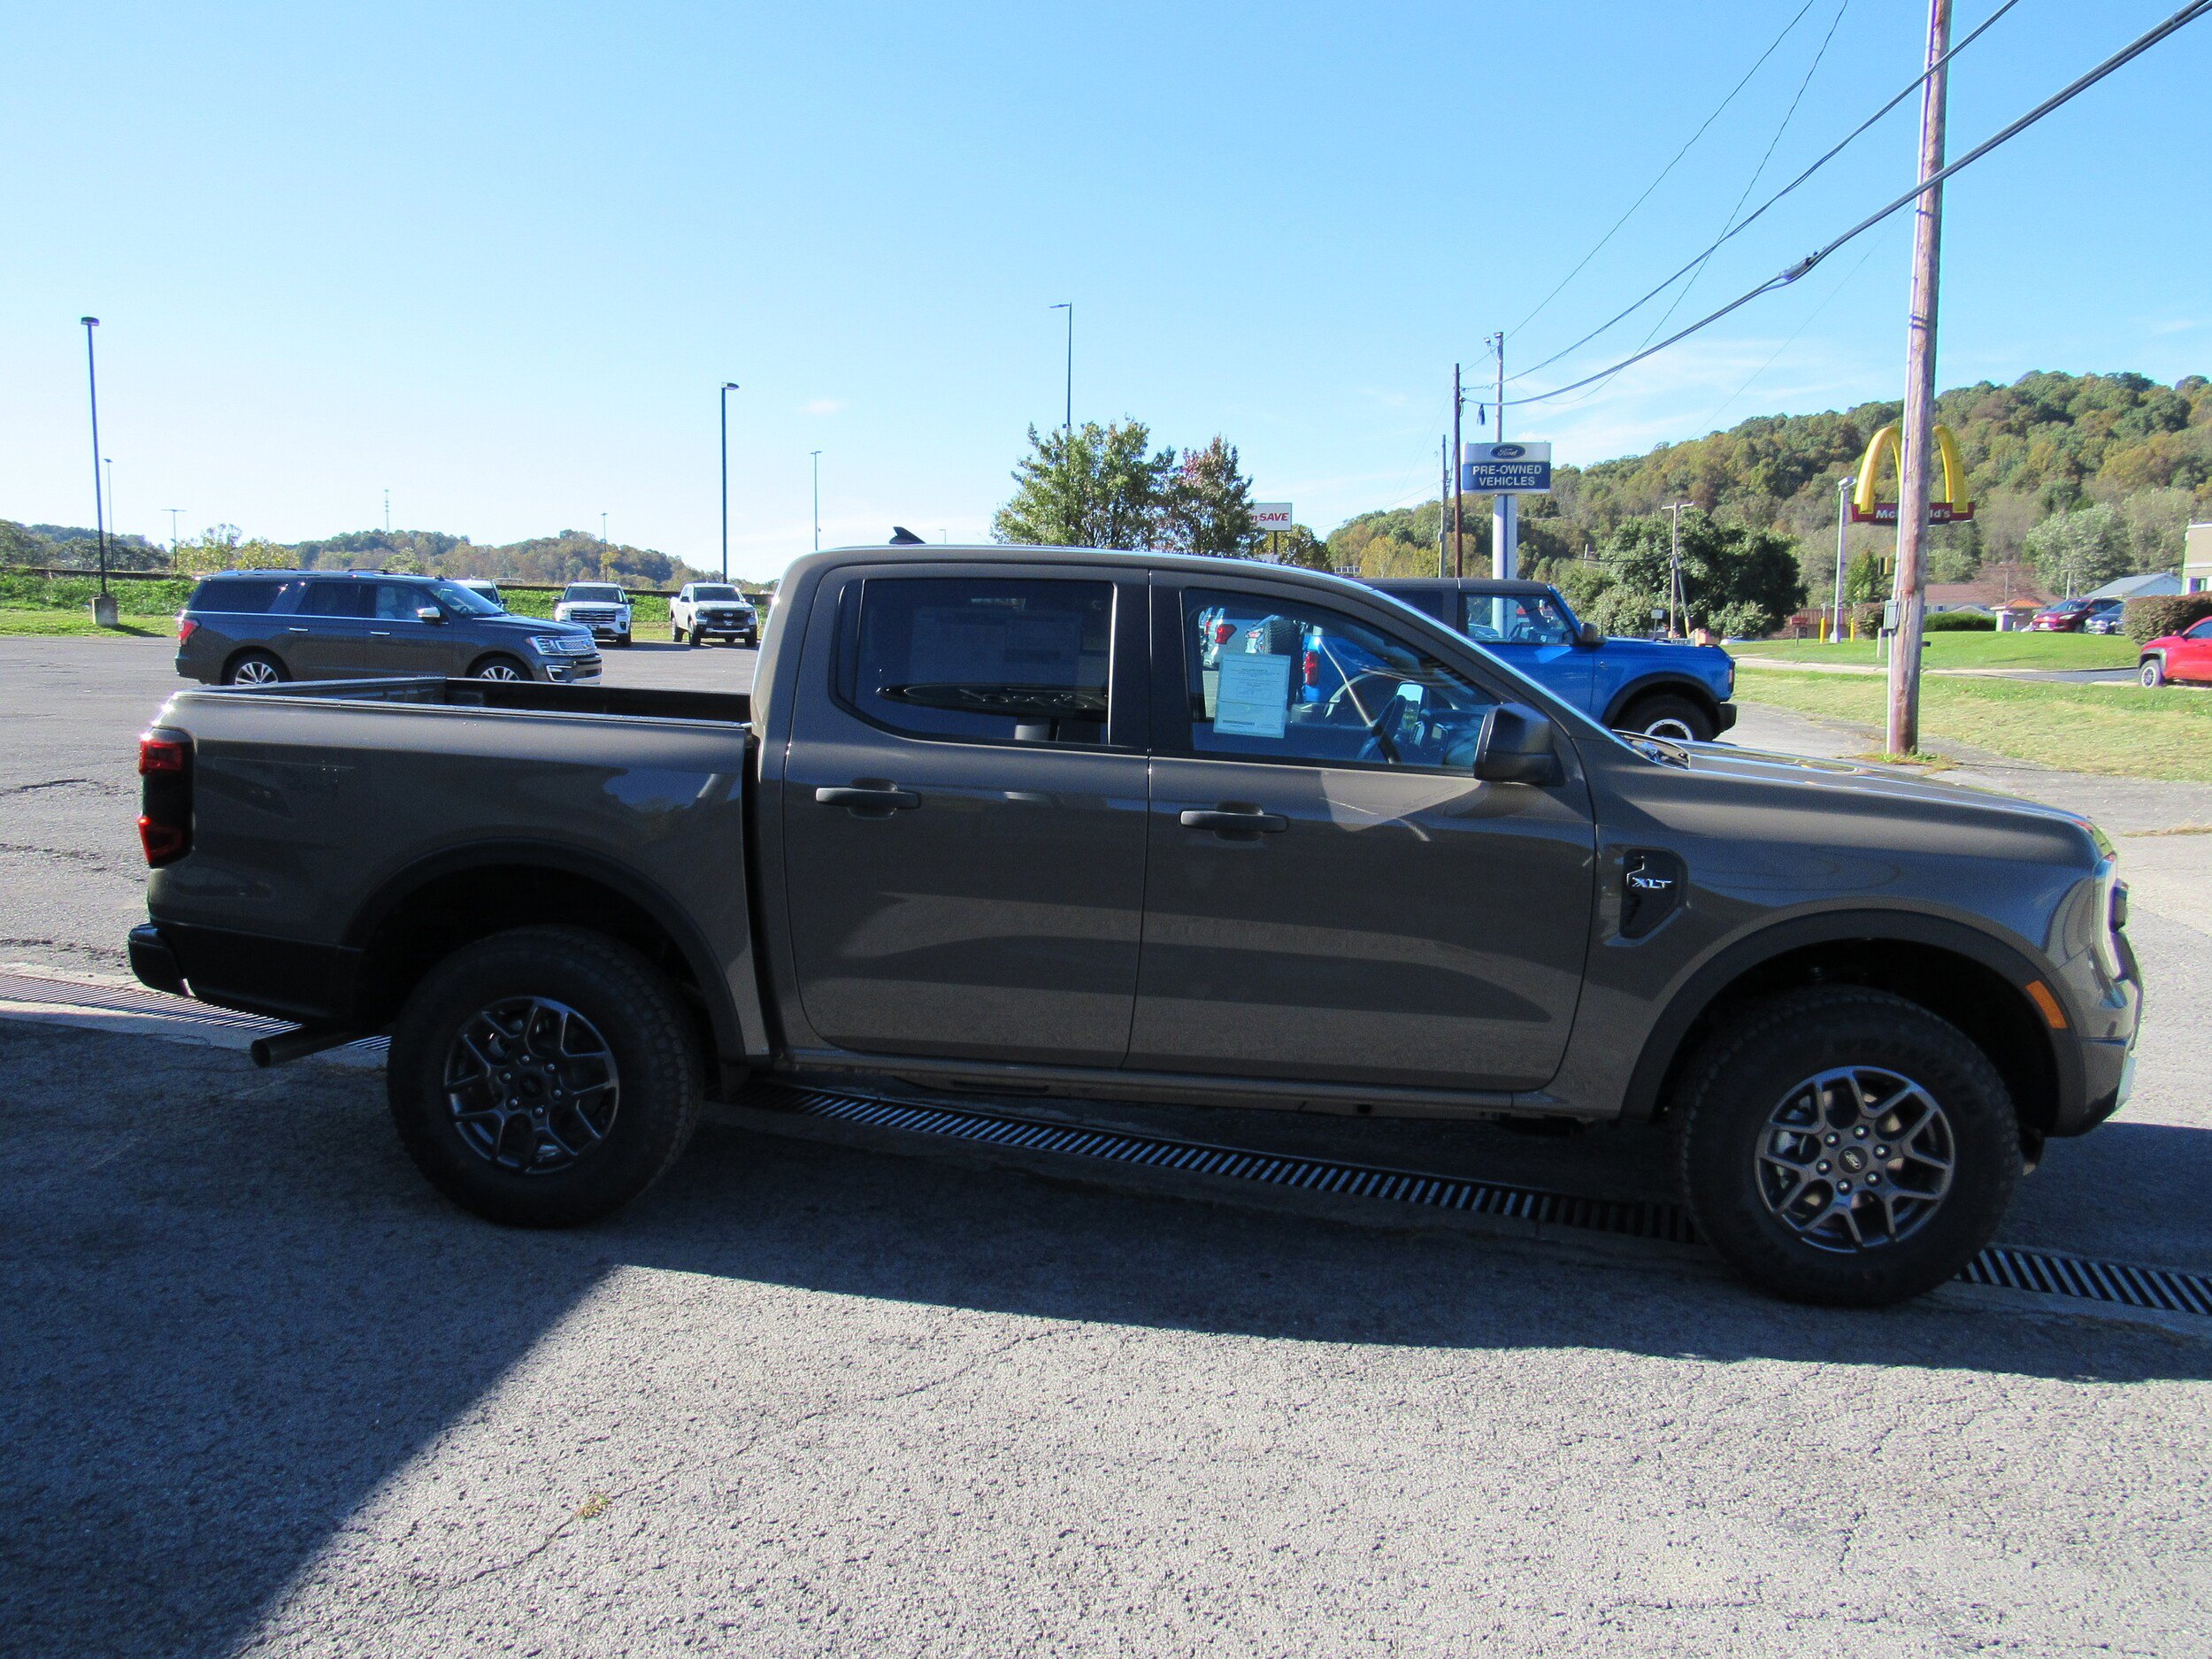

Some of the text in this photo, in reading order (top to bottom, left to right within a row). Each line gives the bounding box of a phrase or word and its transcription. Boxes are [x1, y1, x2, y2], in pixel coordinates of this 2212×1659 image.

[1472, 465, 1542, 475] PRE-OWNED
[1479, 476, 1535, 487] VEHICLES
[1259, 512, 1289, 521] SAVE
[1875, 509, 1951, 518] Mcld's
[1632, 877, 1672, 889] XLT
